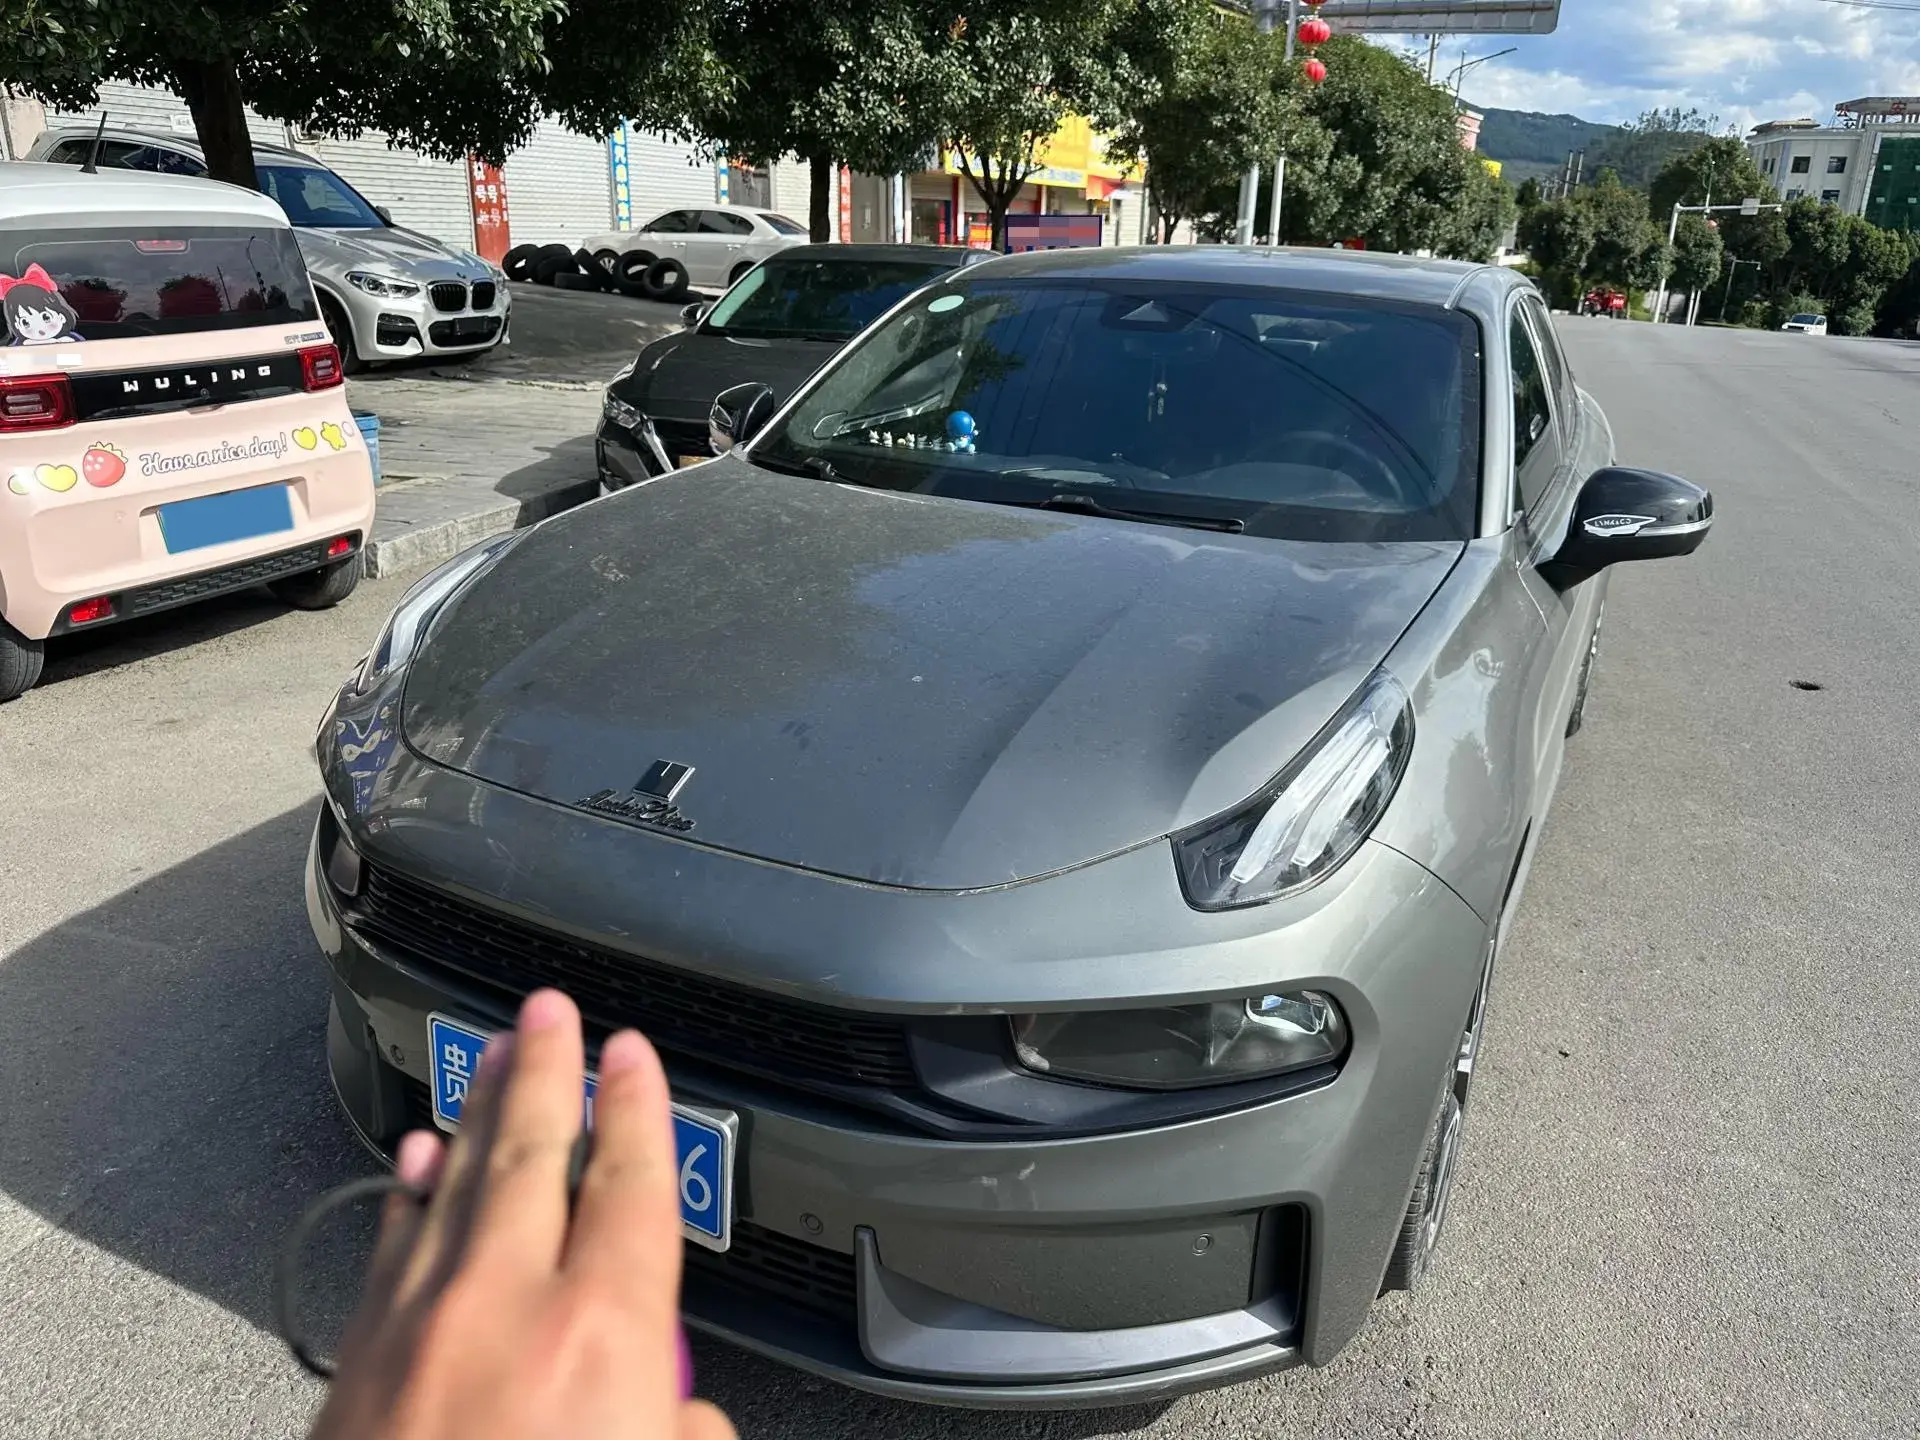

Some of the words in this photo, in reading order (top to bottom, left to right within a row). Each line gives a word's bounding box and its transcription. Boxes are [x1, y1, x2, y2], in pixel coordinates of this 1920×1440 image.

[122, 365, 271, 392] WULING
[139, 452, 196, 476] Have
[196, 451, 211, 467] a
[211, 440, 248, 464] nice
[249, 432, 288, 459] day!
